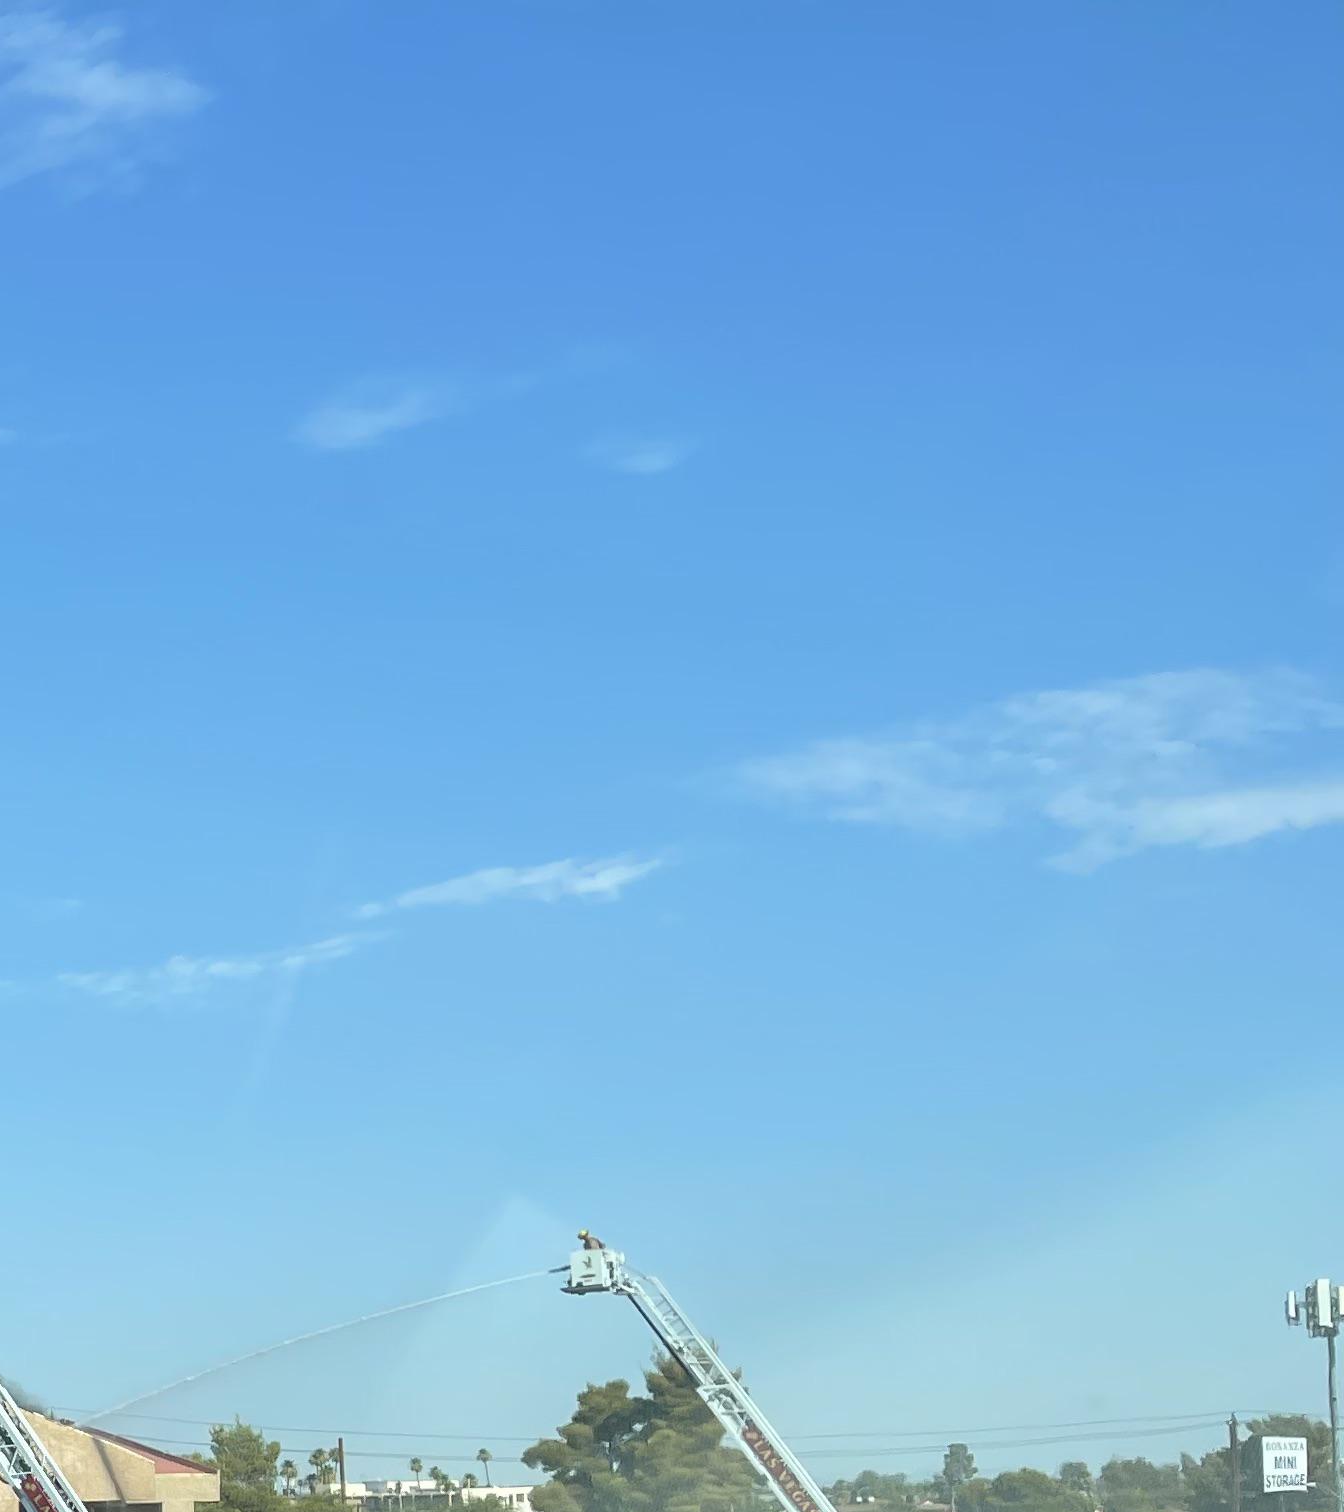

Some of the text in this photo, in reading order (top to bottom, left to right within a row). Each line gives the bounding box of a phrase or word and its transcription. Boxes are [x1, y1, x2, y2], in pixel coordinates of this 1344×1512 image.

[753, 1440, 779, 1468] LAS
[1274, 1455, 1297, 1469] MINI
[1265, 1473, 1305, 1488] STORAGE
